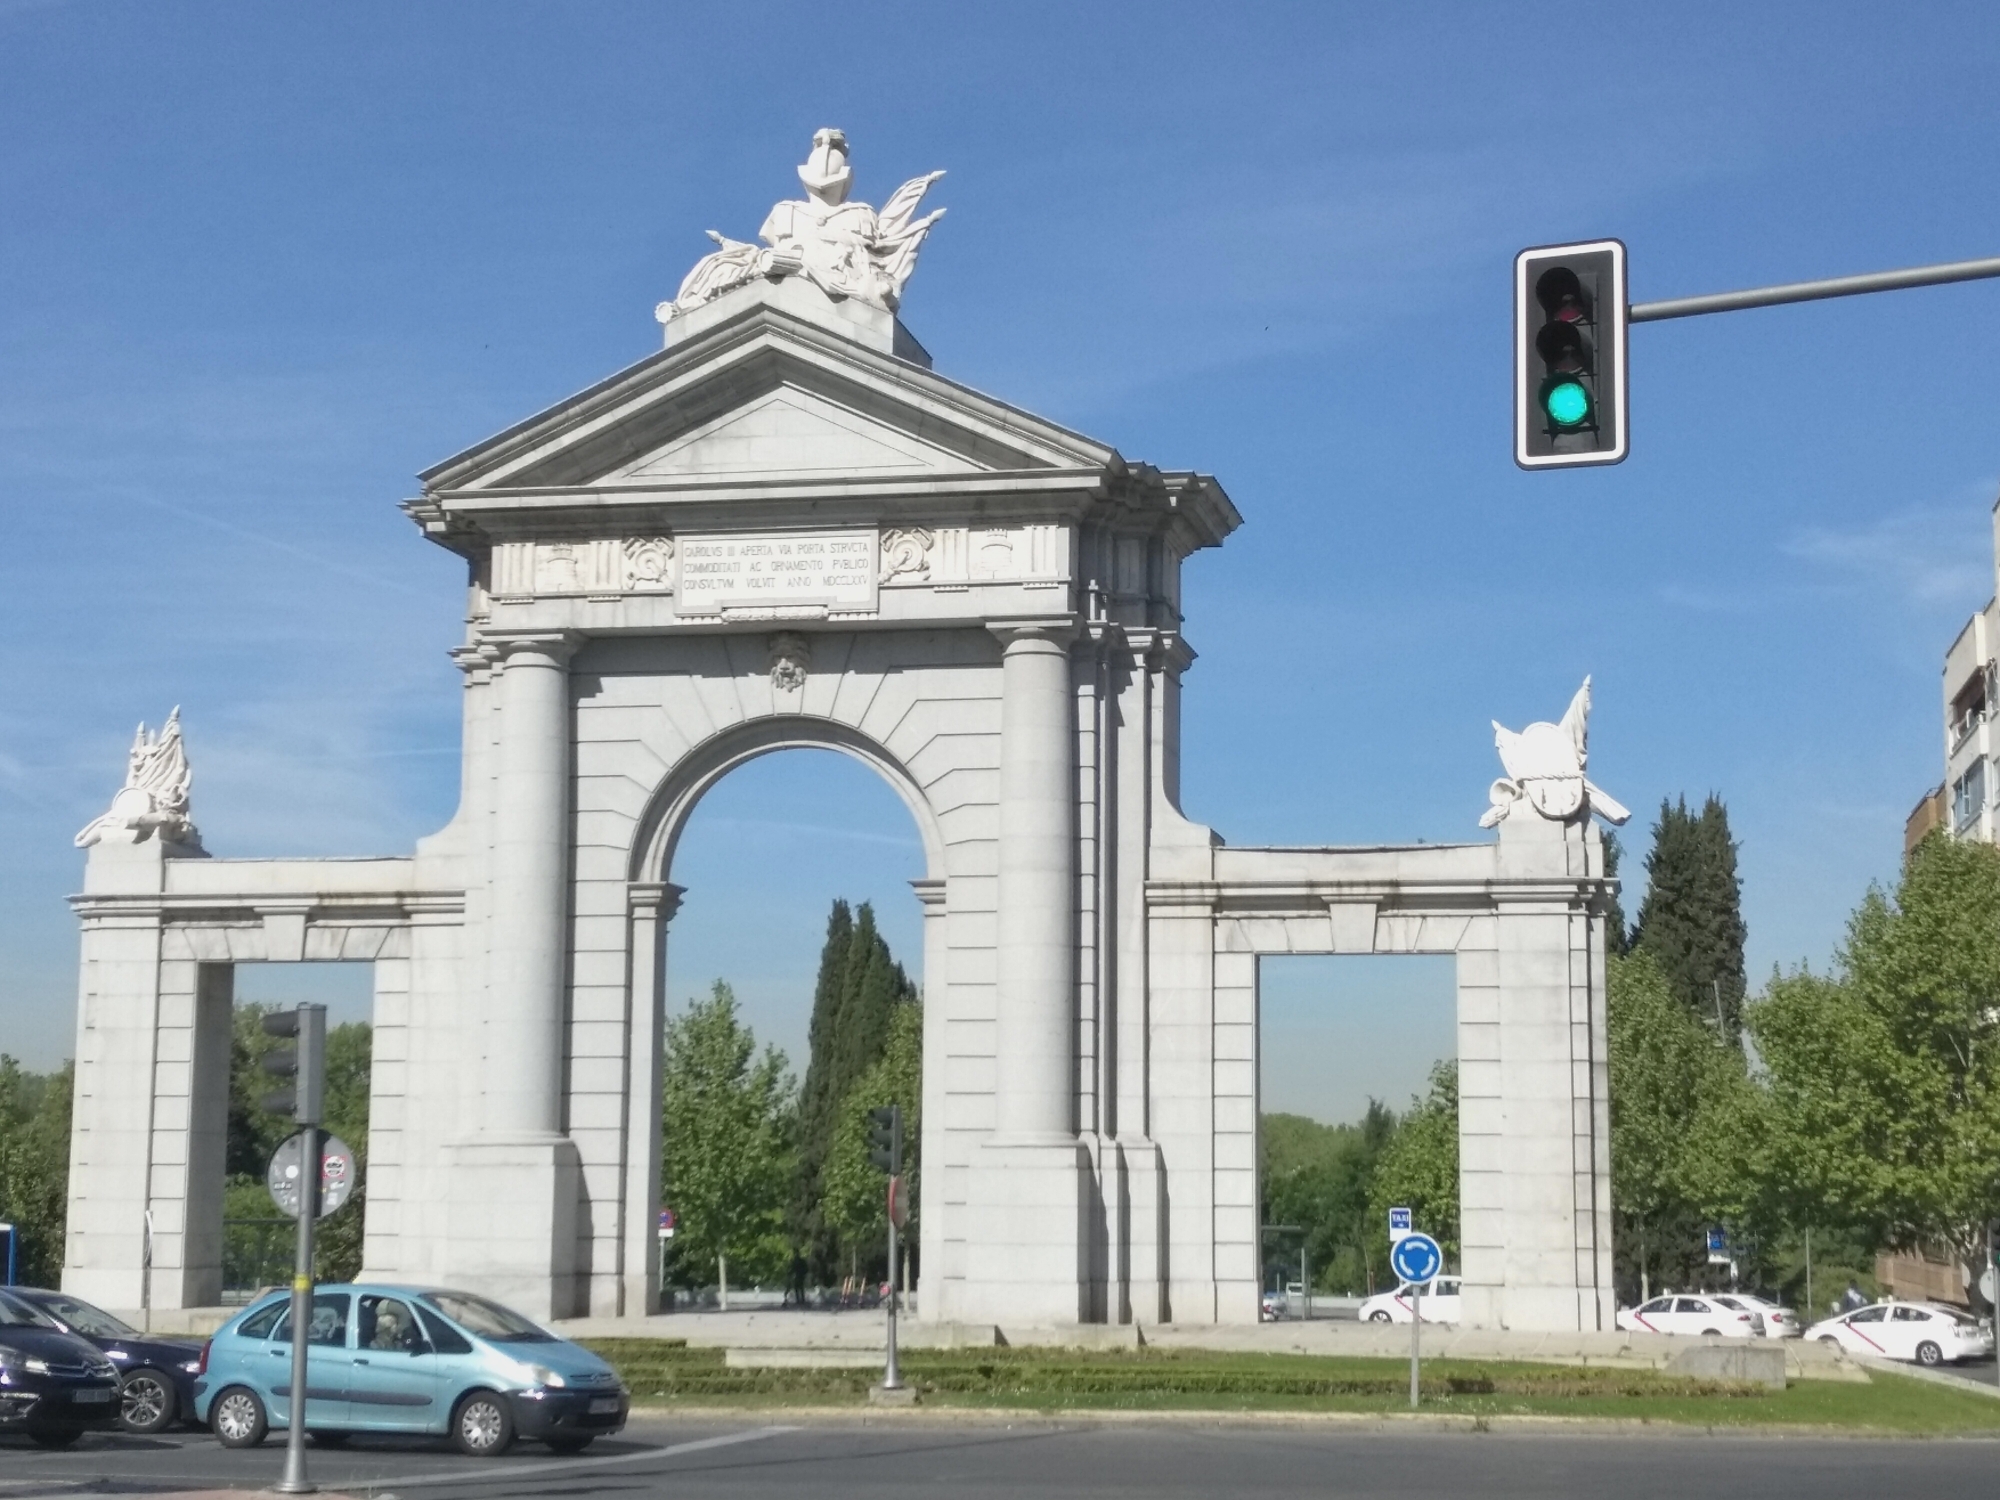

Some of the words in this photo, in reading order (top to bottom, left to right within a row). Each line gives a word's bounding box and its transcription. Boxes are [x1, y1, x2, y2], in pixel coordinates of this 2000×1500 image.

[740, 545, 773, 556] APERTA
[778, 544, 792, 555] VIA
[797, 544, 825, 555] PORTA
[830, 542, 869, 554] STRVCTA
[750, 562, 762, 572] AC
[771, 560, 823, 572] ORNAMENTO
[832, 559, 869, 570] PVBLICO
[684, 578, 734, 590] CONSVLTVM
[746, 577, 775, 589] VOLVIT
[787, 576, 811, 588] ANNO
[1392, 1213, 1409, 1222] TAXI
